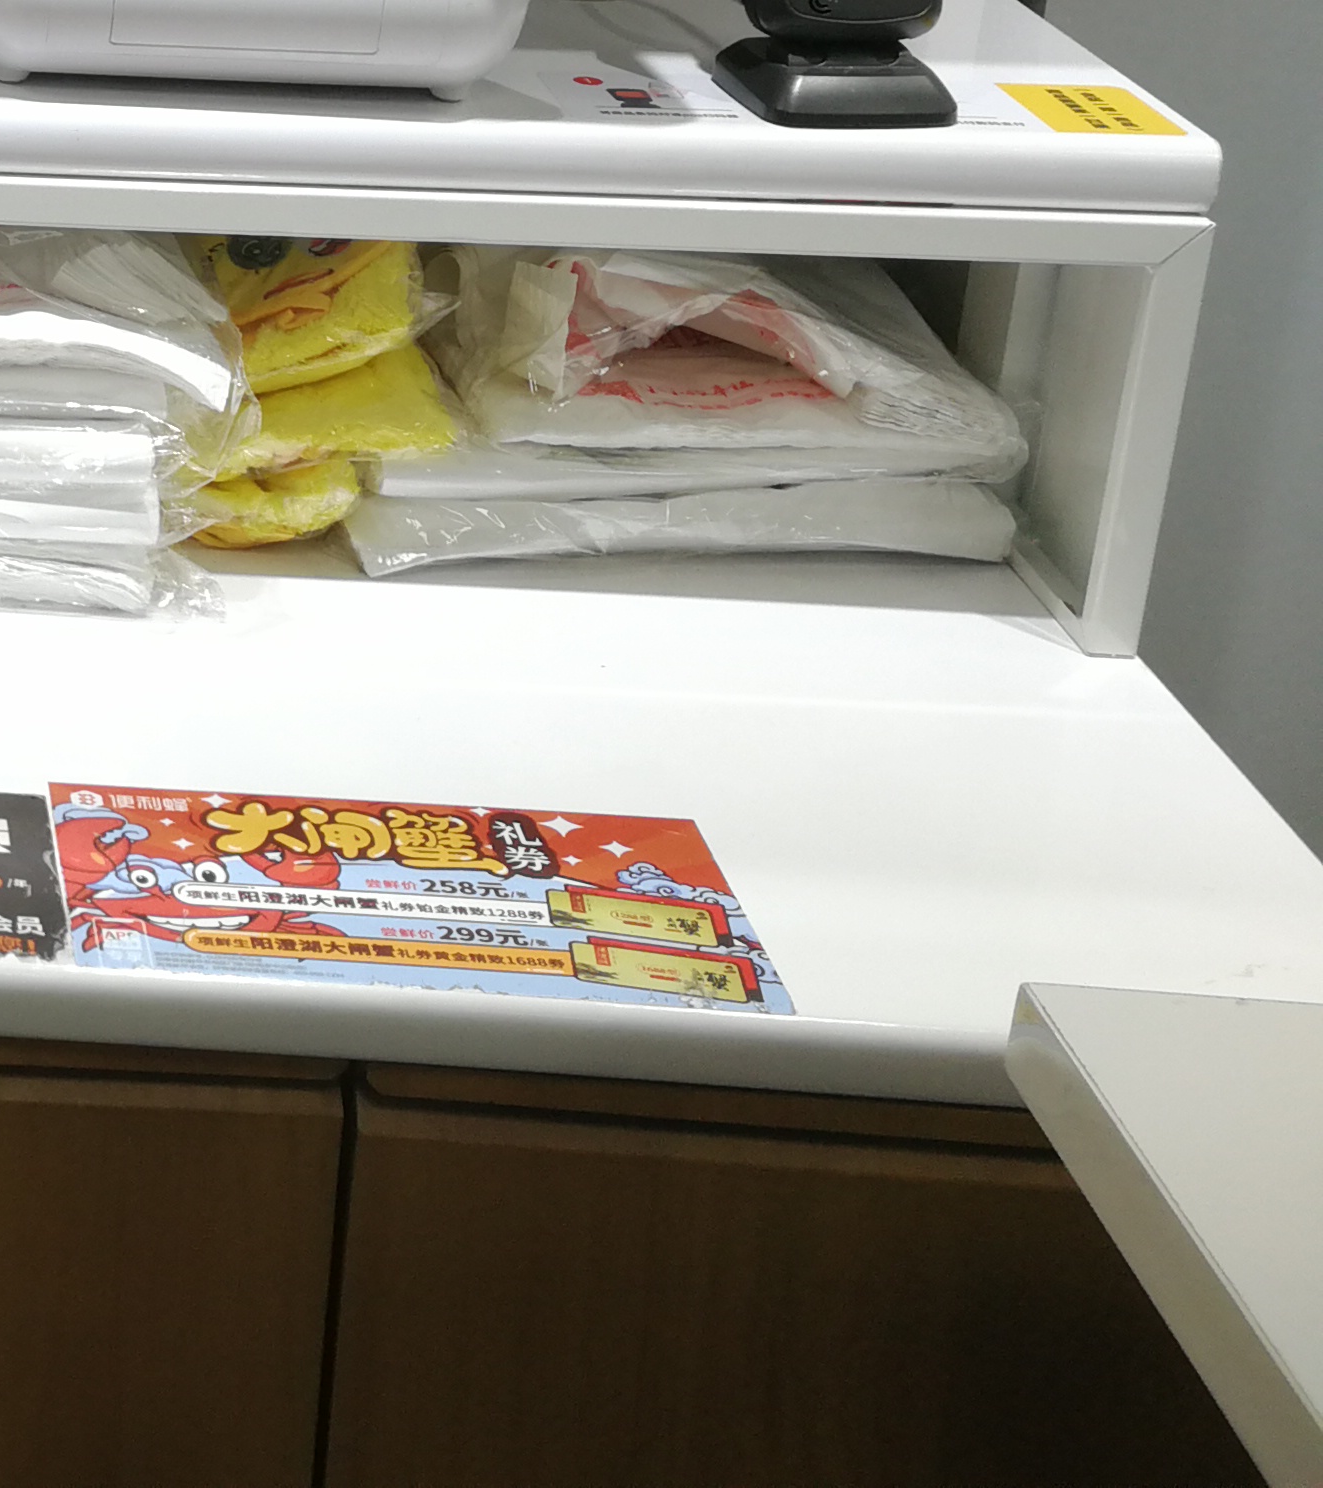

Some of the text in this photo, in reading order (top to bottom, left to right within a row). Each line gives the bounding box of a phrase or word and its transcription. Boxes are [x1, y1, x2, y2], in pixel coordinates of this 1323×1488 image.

[109, 793, 192, 813] 便利蜂
[207, 801, 509, 875] 大闸蟹
[494, 819, 552, 873] 礼券
